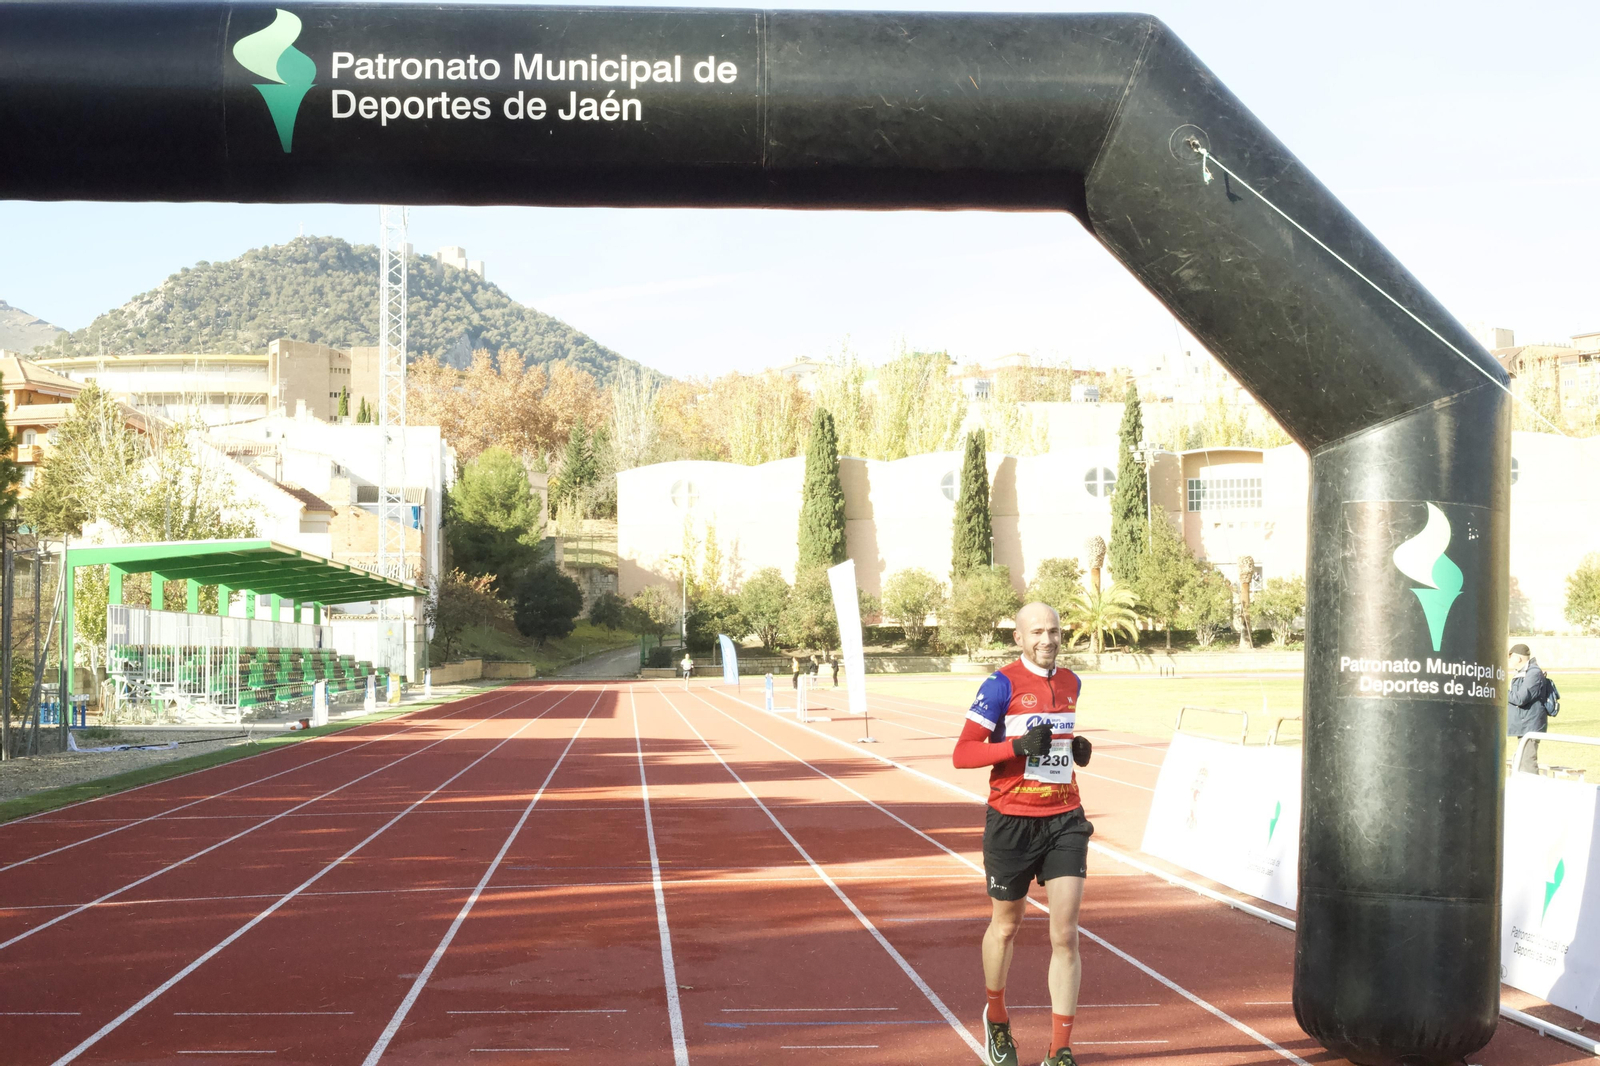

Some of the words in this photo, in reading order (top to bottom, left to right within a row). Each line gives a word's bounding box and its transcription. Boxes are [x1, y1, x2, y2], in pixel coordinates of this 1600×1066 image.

[331, 51, 501, 81] Patronato
[513, 52, 683, 89] Municipal
[692, 54, 739, 84] de
[331, 89, 491, 127] Deportes
[503, 90, 547, 120] de
[558, 87, 642, 121] Jaén
[1340, 656, 1421, 673] Patronato
[1426, 657, 1494, 681] Municipal
[1496, 666, 1506, 681] de
[1359, 675, 1439, 696] Deportes
[1443, 679, 1464, 695] de
[1467, 682, 1496, 699] Jaén
[1041, 755, 1070, 767] 230
